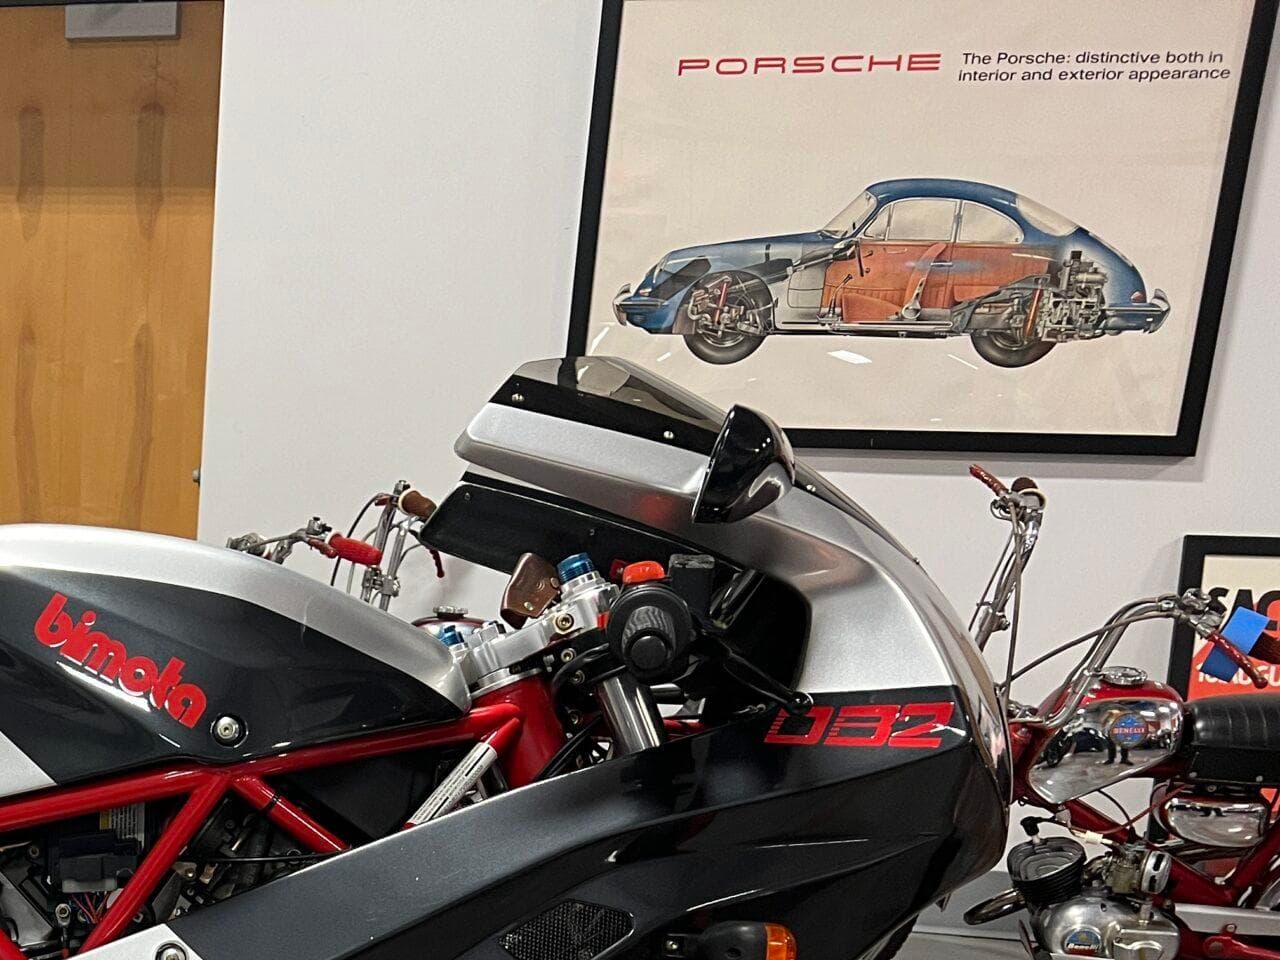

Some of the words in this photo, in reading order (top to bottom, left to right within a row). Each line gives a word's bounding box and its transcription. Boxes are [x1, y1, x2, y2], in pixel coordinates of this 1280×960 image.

[677, 53, 942, 77] PORSCHE
[962, 52, 992, 65] The
[996, 52, 1071, 65] Porsche:
[1075, 51, 1161, 64] distinctive
[1165, 51, 1204, 64] both
[1208, 51, 1224, 64] in
[957, 69, 1017, 82] interior
[1021, 69, 1053, 81] and
[1058, 68, 1124, 81] exterior
[1128, 68, 1231, 83] appearance
[34, 591, 207, 729] bimota
[763, 701, 956, 748] DB2
